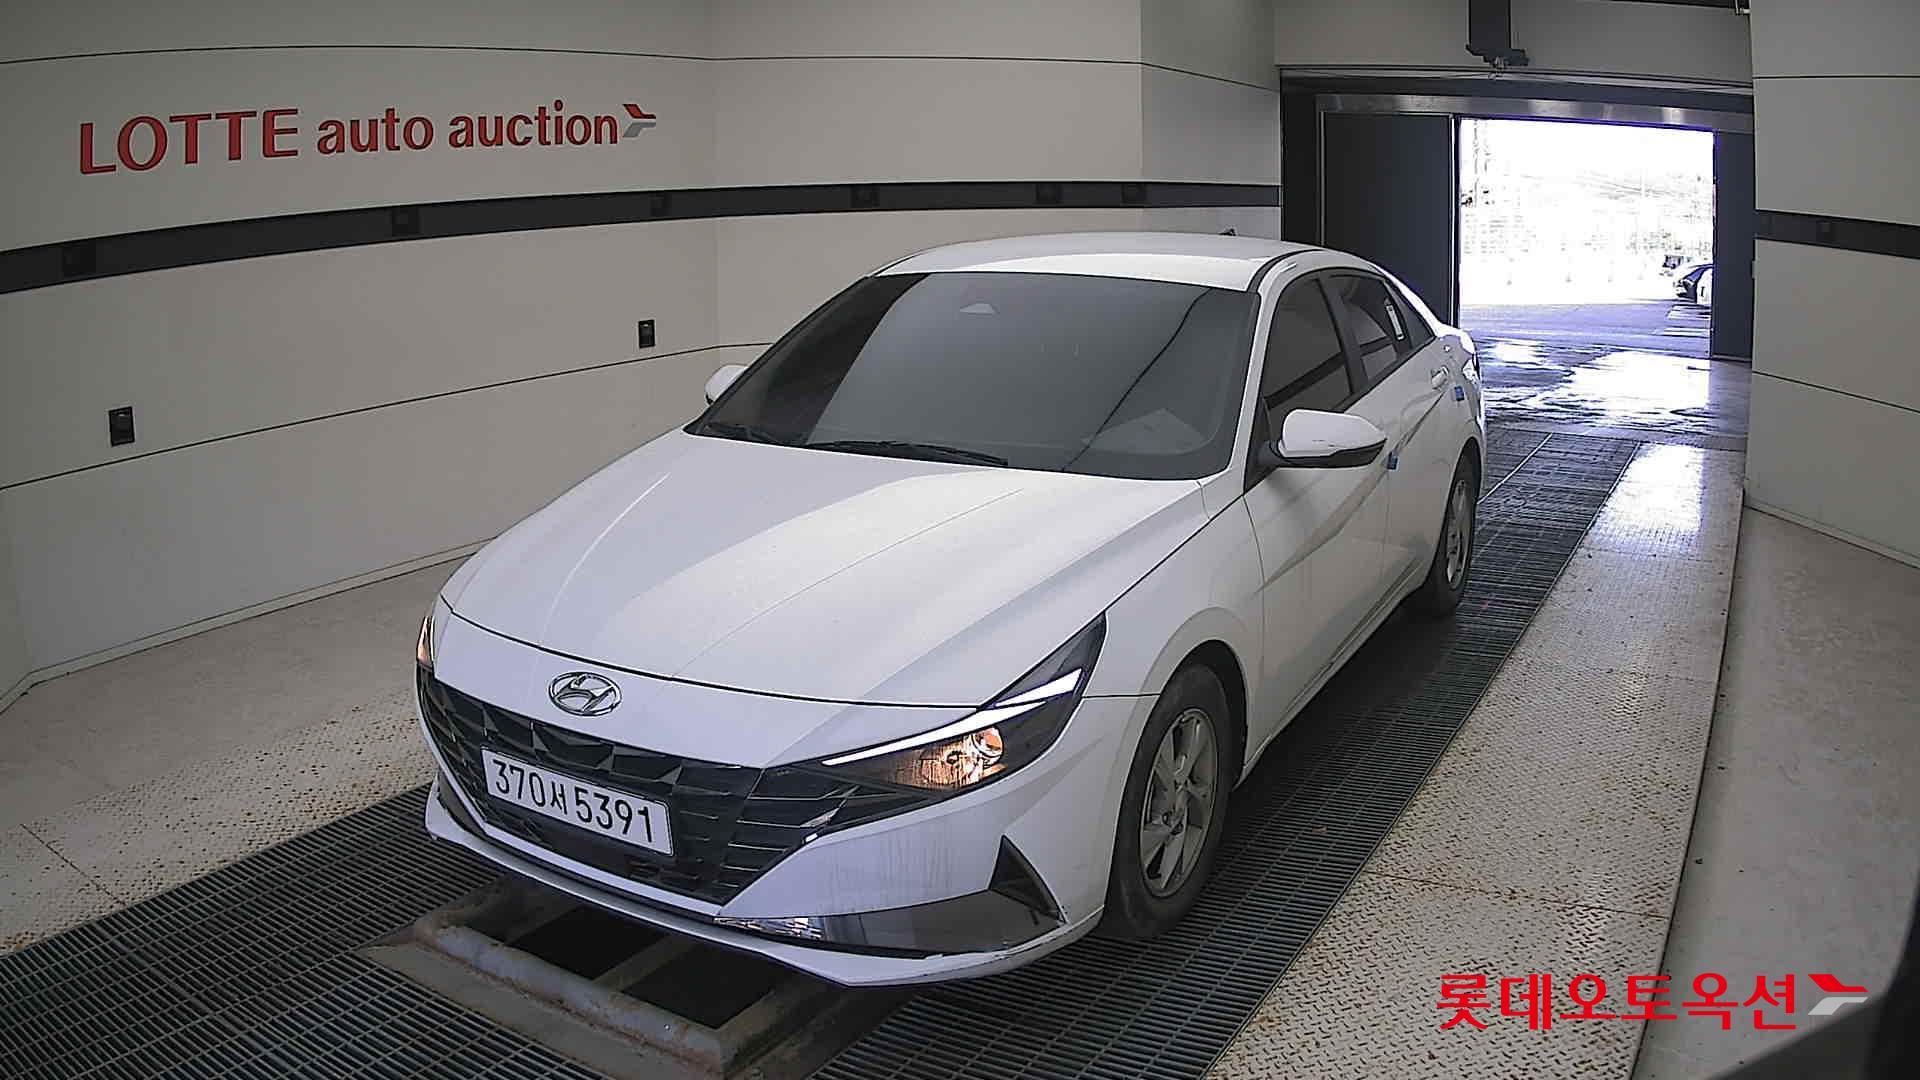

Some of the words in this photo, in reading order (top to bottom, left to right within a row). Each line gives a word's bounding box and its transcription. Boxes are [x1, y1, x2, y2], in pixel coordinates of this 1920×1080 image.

[79, 108, 299, 175] LOTTE
[317, 107, 434, 155] auto
[448, 99, 619, 148] auction
[574, 785, 653, 843] 5391
